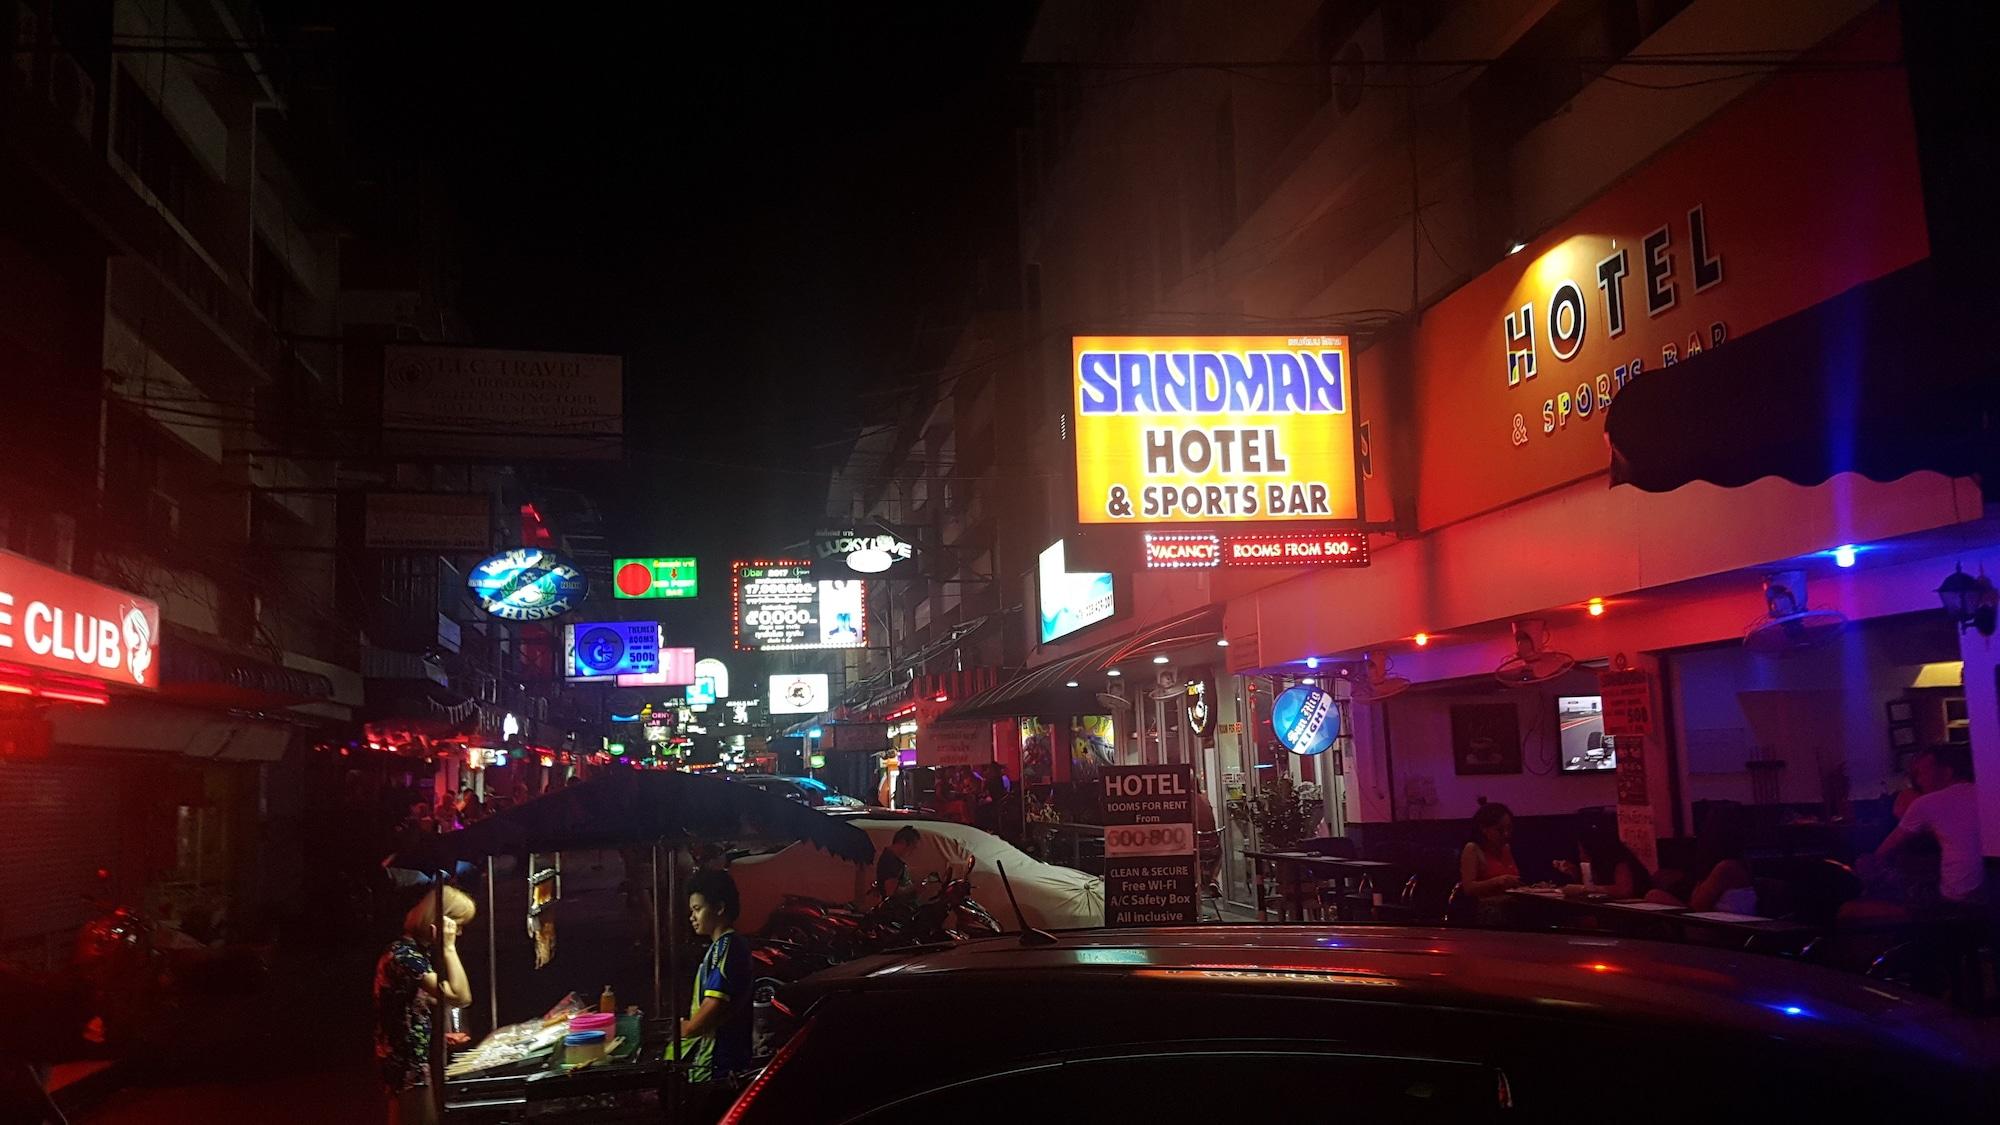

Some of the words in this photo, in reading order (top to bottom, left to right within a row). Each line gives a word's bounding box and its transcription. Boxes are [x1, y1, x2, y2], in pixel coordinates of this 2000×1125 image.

[1504, 203, 1723, 386] HOTEL
[496, 359, 588, 377] TRAVEL
[1080, 352, 1344, 413] SANDMAN
[1512, 413, 1528, 445] &
[1542, 358, 1642, 432] SPORTS
[1146, 430, 1286, 474] HOTEL
[1108, 486, 1131, 516] &
[1143, 485, 1257, 515] SPORTS
[1267, 484, 1329, 514] BAR
[1152, 545, 1214, 559] VACANCY
[1234, 544, 1281, 557] ROOMS
[1285, 543, 1321, 556] FROM
[482, 597, 572, 620] WHISKY
[24, 601, 121, 669] CLUB
[629, 636, 654, 644] ROOMS
[630, 652, 655, 662] 500b
[1300, 702, 1327, 747] LIGHT
[1104, 773, 1186, 797] HOTEL
[1107, 802, 1141, 812] ROOMS
[1142, 801, 1161, 811] FOR
[1163, 800, 1188, 810] RENT
[1136, 814, 1160, 823] From
[1110, 867, 1140, 878] CLEAN
[1142, 867, 1150, 877] &
[1151, 866, 1188, 876] SECURE
[1122, 881, 1146, 891] Free
[1110, 895, 1130, 907] A/C
[1131, 894, 1168, 907] Safety
[1169, 893, 1191, 904] Box
[1116, 912, 1132, 923] All
